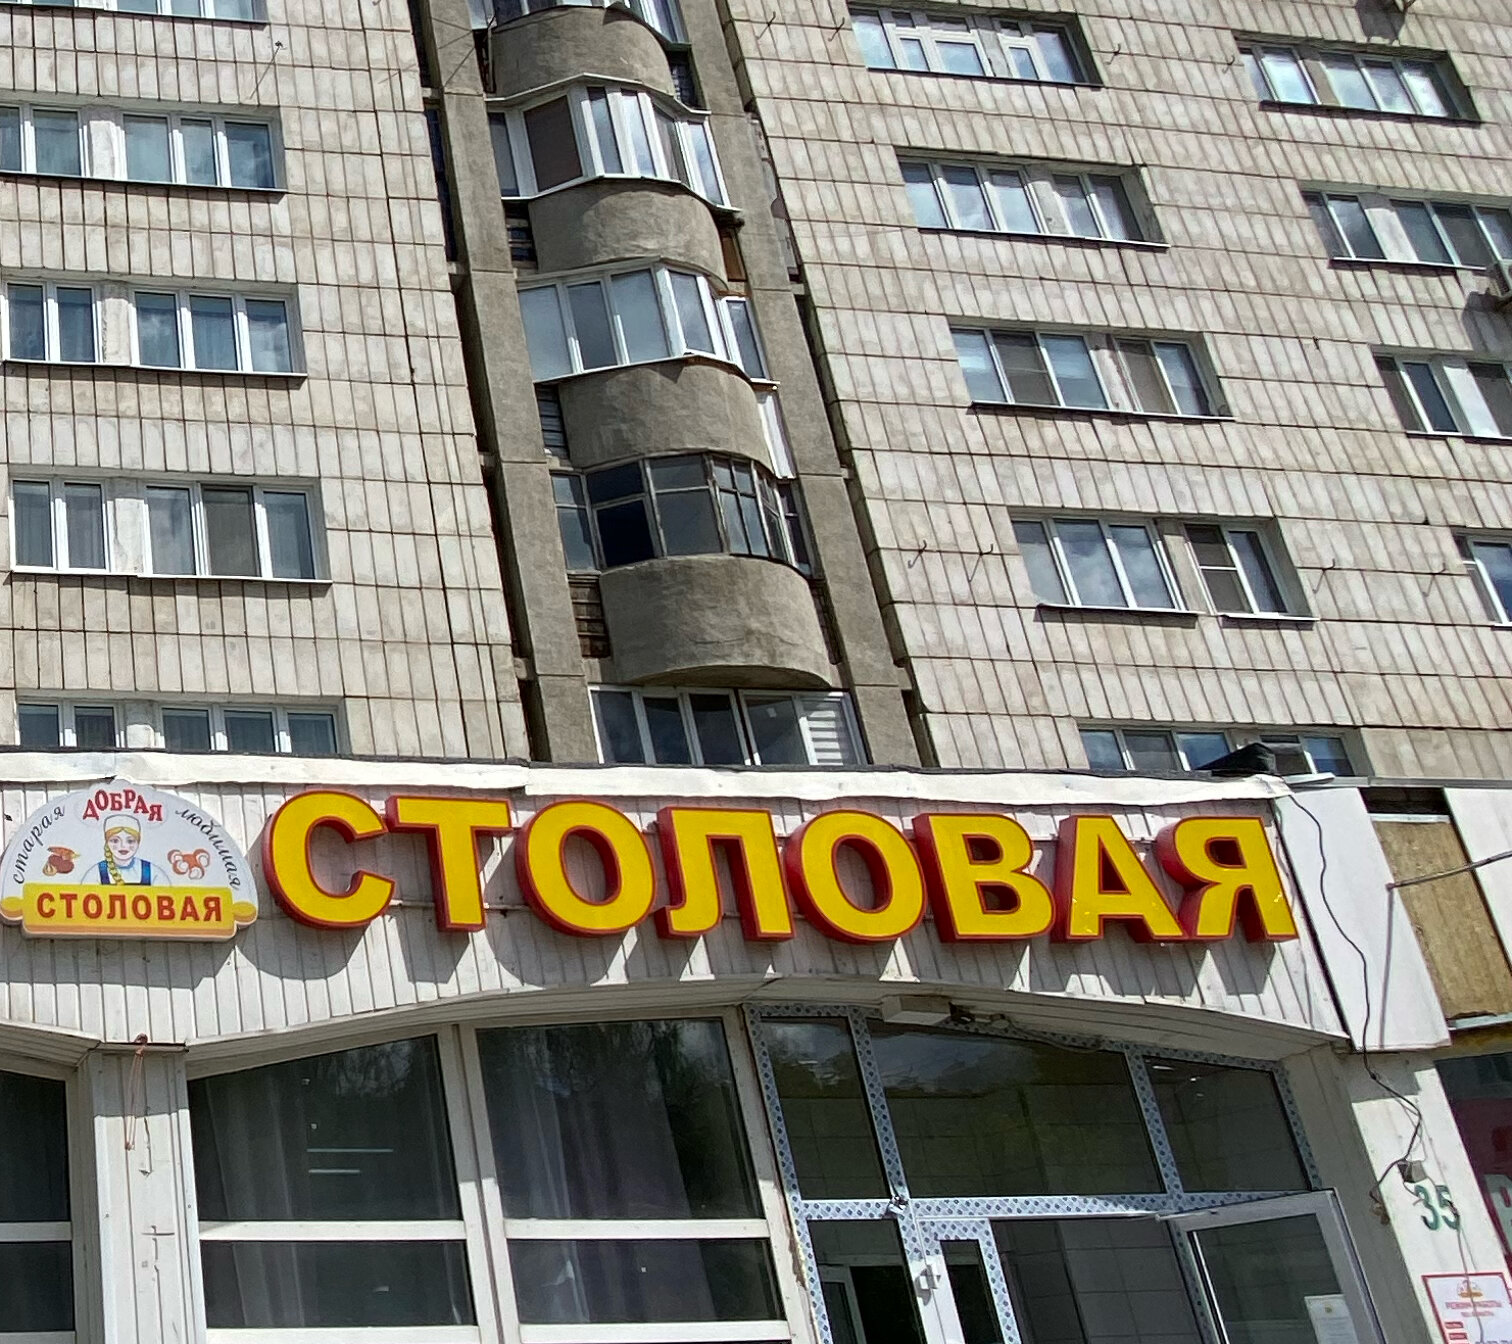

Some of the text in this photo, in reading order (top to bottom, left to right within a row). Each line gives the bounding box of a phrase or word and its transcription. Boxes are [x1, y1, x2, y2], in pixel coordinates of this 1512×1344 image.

[82, 788, 164, 822] ДОБРАЯ
[13, 805, 65, 885] старая
[174, 808, 242, 891] любимая
[263, 789, 1297, 945] СТОЛОВАЯ
[36, 891, 223, 923] СТОЛОВАЯ
[1414, 1184, 1460, 1231] 35
